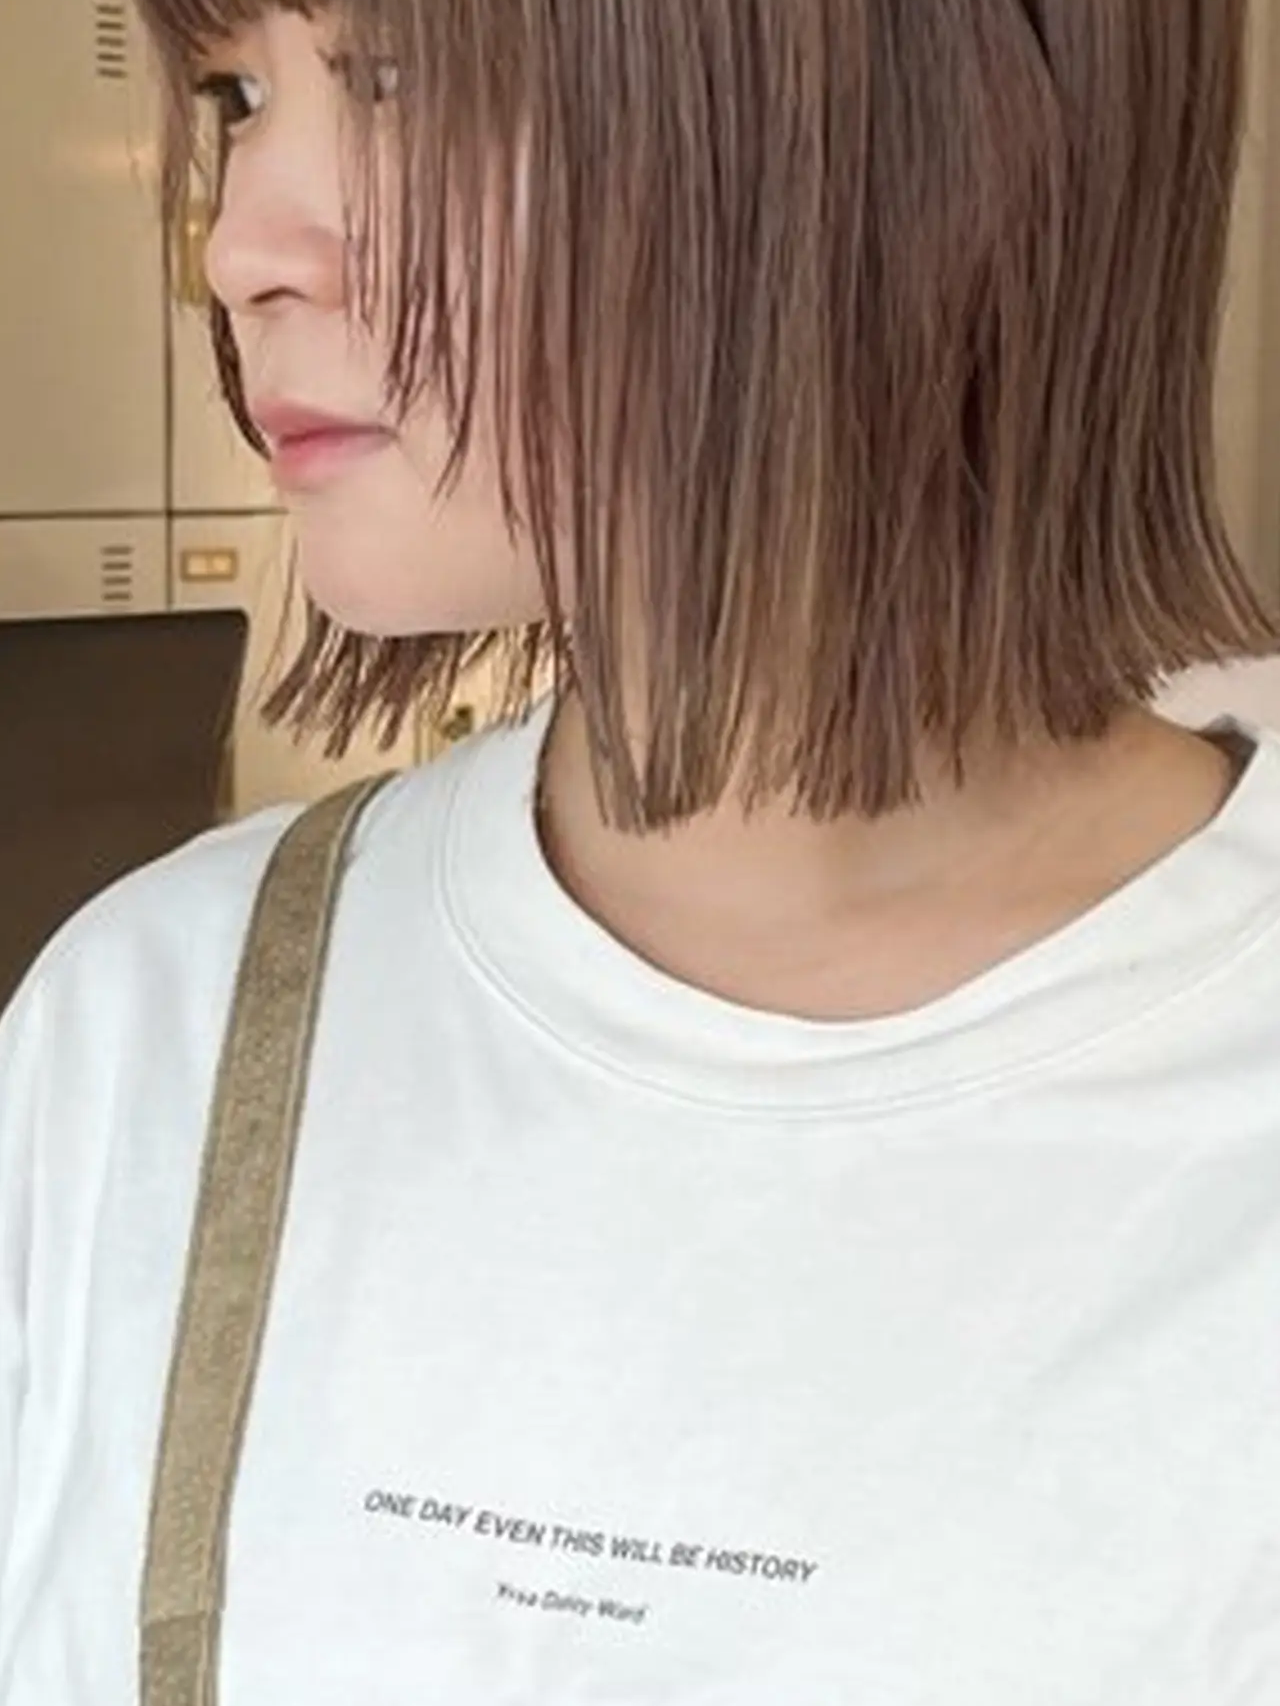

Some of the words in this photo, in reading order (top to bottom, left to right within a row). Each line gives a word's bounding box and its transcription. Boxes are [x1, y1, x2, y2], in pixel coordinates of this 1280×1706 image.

[364, 1489, 417, 1518] ONE
[419, 1497, 471, 1529] DAY
[473, 1509, 546, 1546] EVEN
[549, 1524, 605, 1557] THIS
[610, 1536, 662, 1564] WILL
[669, 1541, 703, 1568] BE
[705, 1547, 818, 1583] HISTORY
